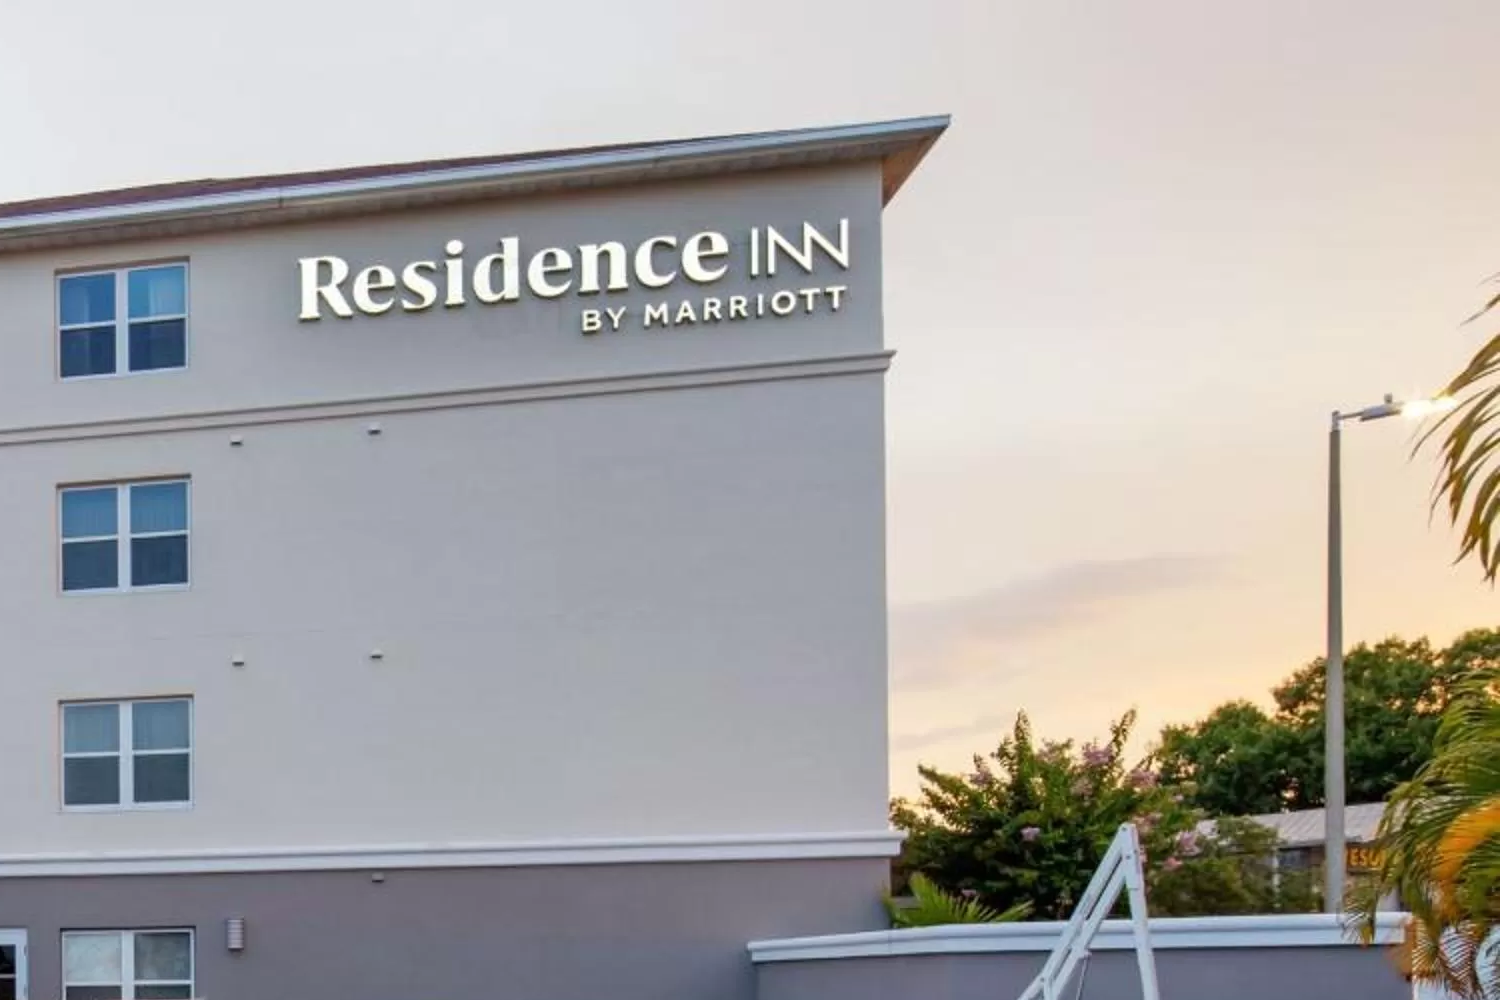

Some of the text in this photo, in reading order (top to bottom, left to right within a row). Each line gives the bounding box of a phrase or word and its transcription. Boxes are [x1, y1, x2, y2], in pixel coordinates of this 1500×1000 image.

[298, 217, 849, 320] Residence INN
[581, 285, 848, 333] BY MARRIOTT
